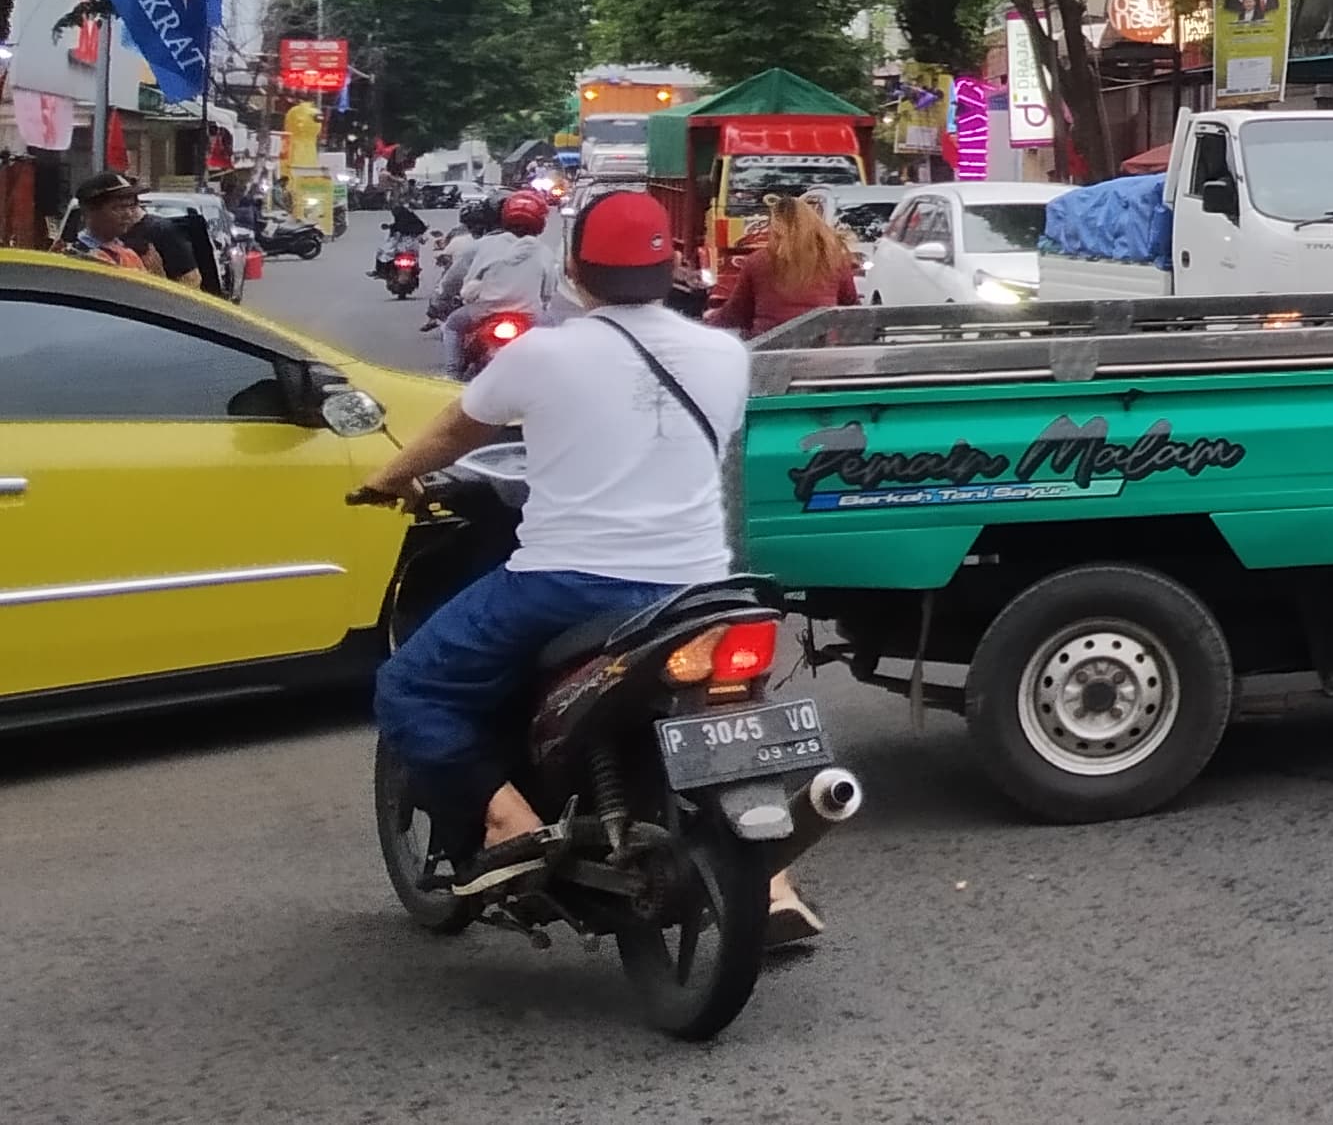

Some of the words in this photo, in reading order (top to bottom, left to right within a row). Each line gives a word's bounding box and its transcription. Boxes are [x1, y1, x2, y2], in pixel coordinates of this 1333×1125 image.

[838, 486, 933, 507] Berkah
[936, 486, 989, 502] Tani
[991, 484, 1069, 501] Sayur
[701, 716, 764, 747] 3045
